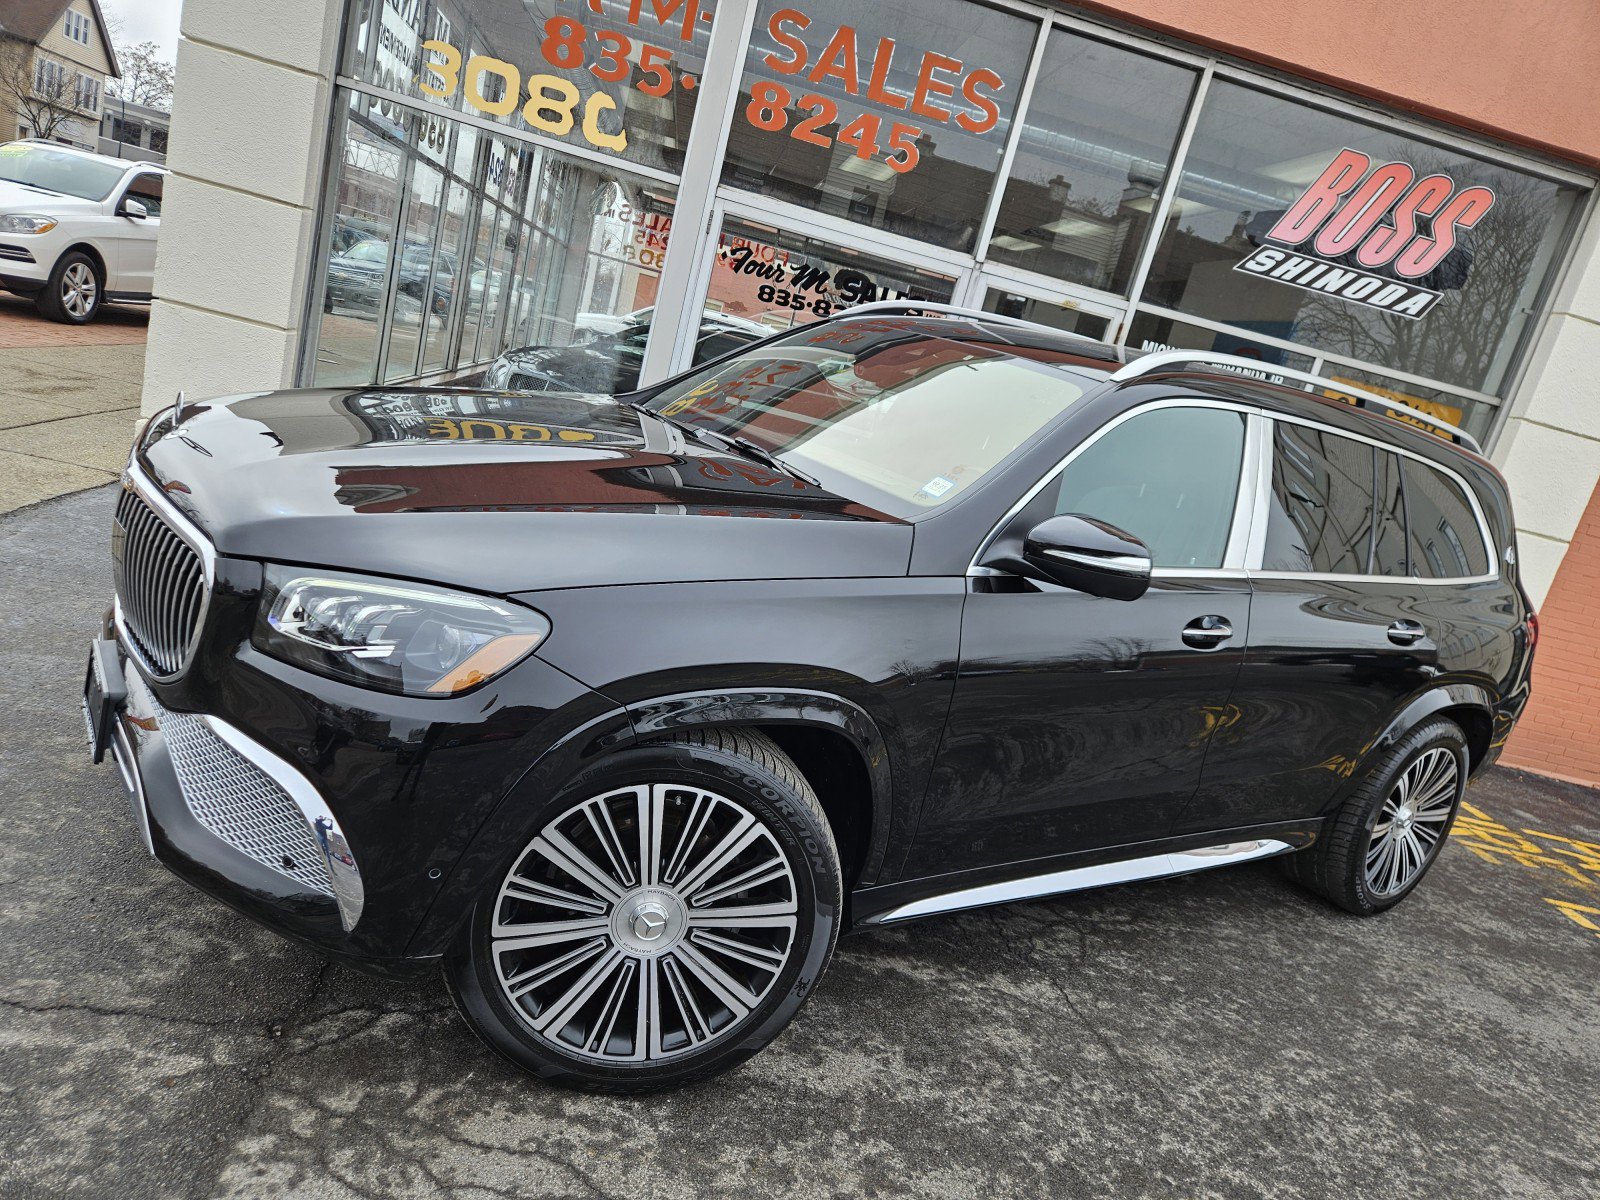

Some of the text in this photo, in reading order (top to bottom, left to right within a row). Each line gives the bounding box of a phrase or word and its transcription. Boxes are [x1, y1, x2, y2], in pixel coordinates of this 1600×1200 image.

[763, 8, 1005, 135] SALES
[746, 81, 923, 173] 8245
[1265, 147, 1496, 279] BOSS
[720, 246, 785, 283] Four
[790, 263, 831, 295] M
[1245, 249, 1434, 316] SHINODA
[720, 765, 828, 875] SCORPION
[750, 799, 798, 847] WINTER
[647, 889, 677, 903] MAYBACH
